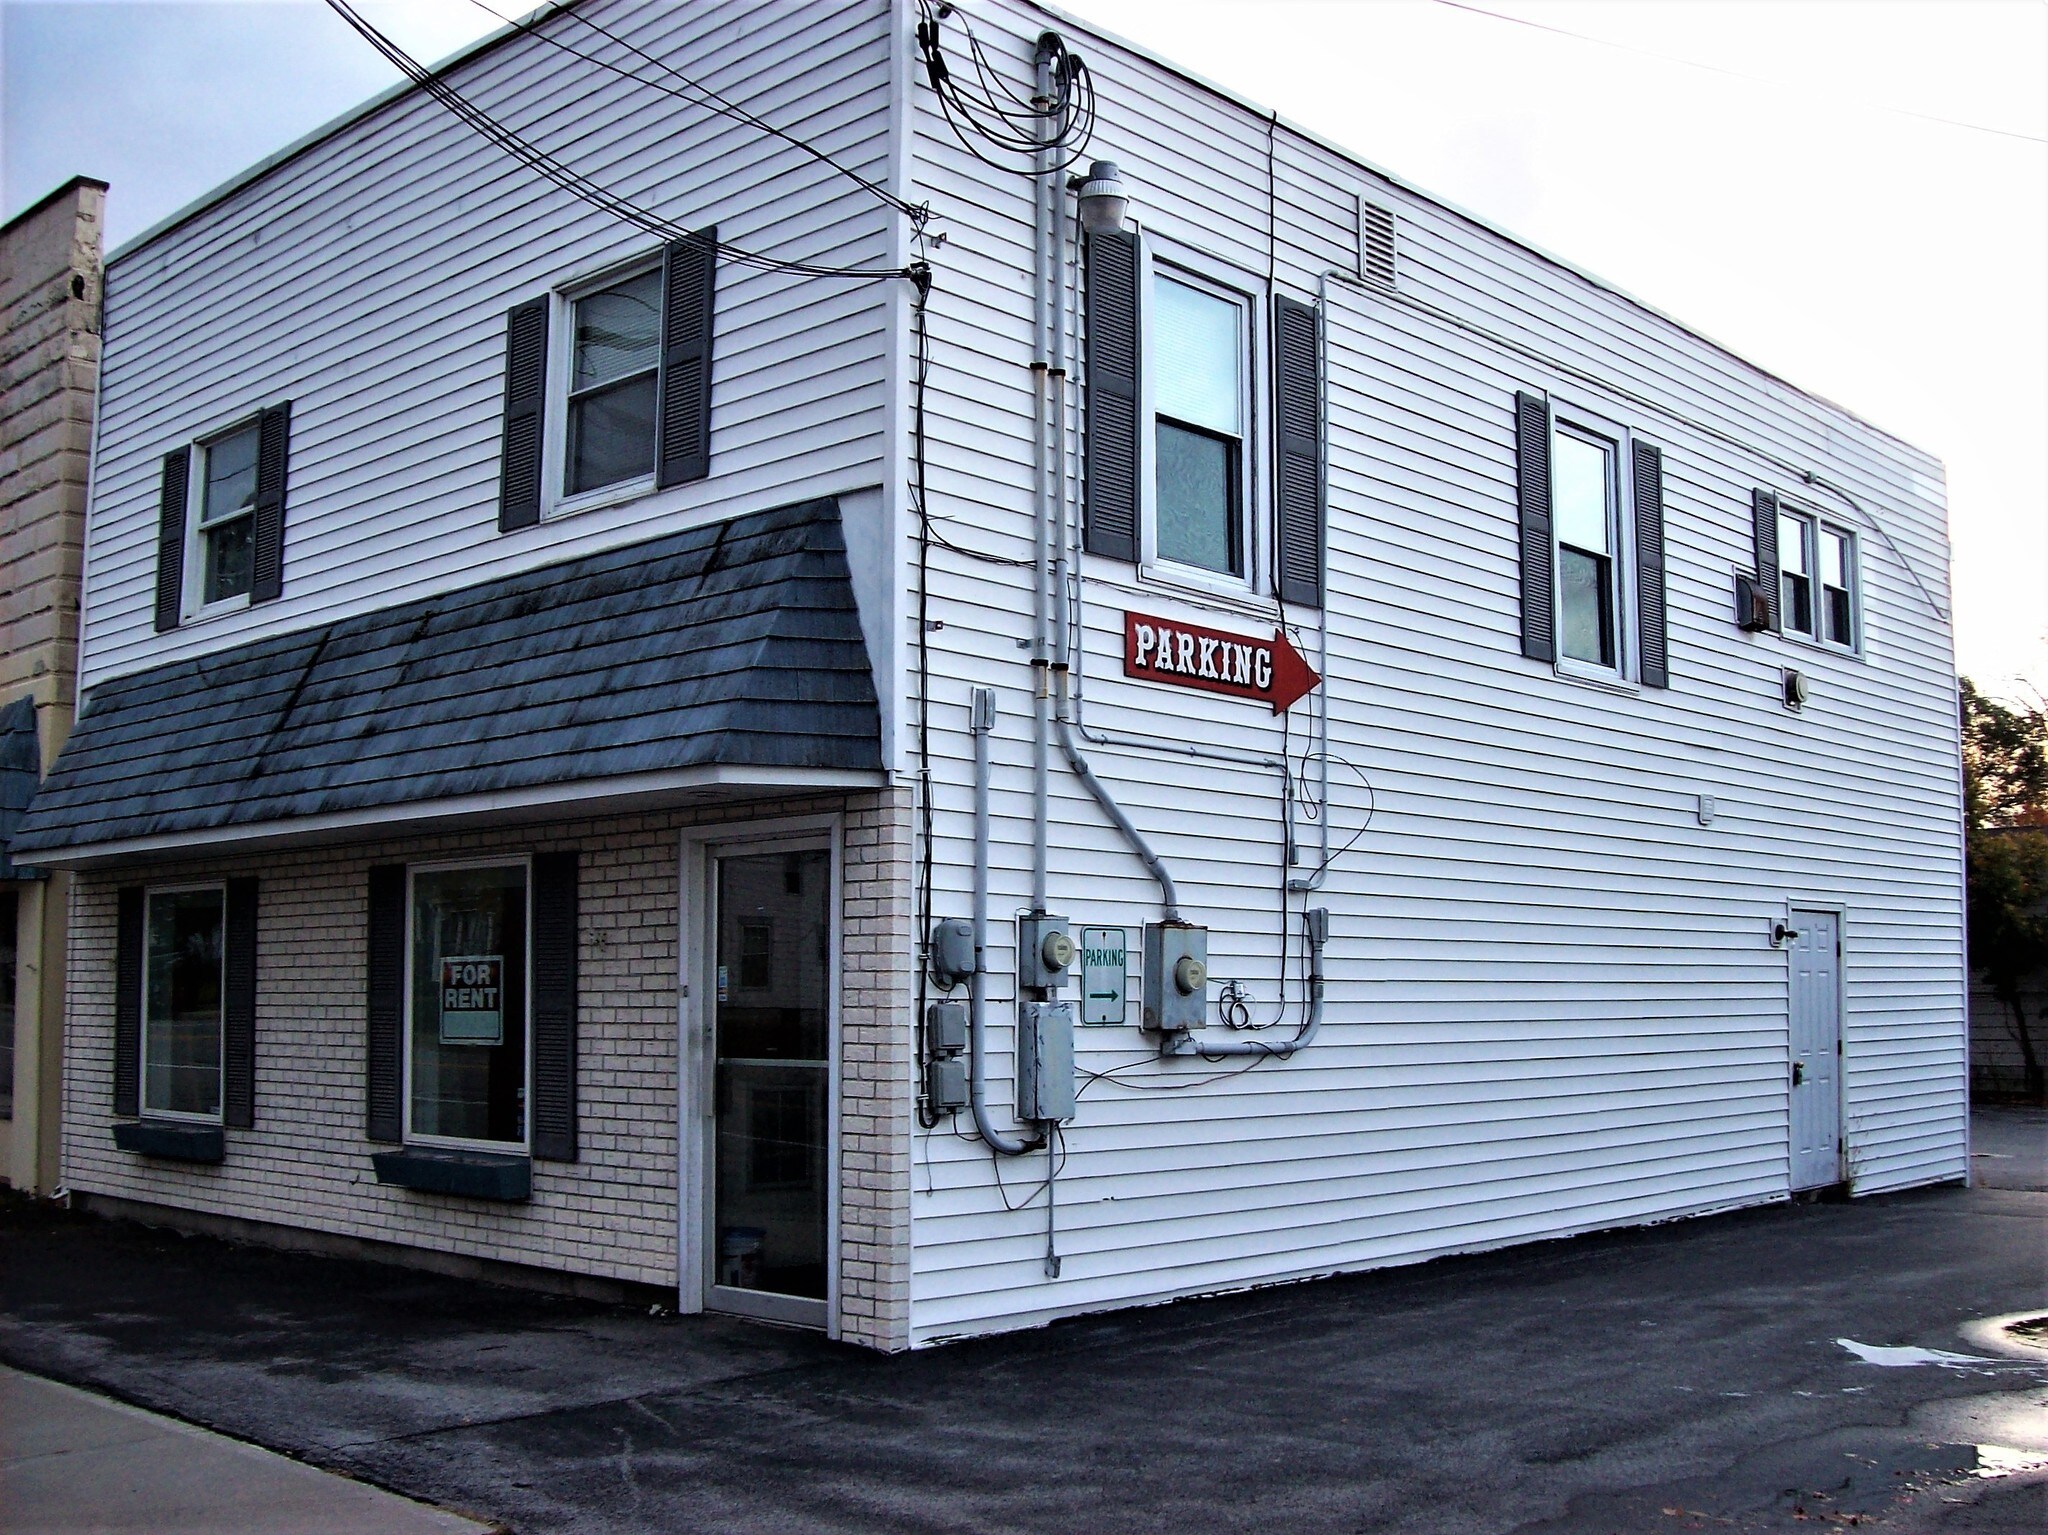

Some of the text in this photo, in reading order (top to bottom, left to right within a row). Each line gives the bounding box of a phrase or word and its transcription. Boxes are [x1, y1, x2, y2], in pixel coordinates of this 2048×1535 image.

[1135, 623, 1272, 688] PARKING
[1085, 948, 1124, 967] PARKING
[450, 964, 491, 985] FOR
[445, 987, 498, 1008] RENT
